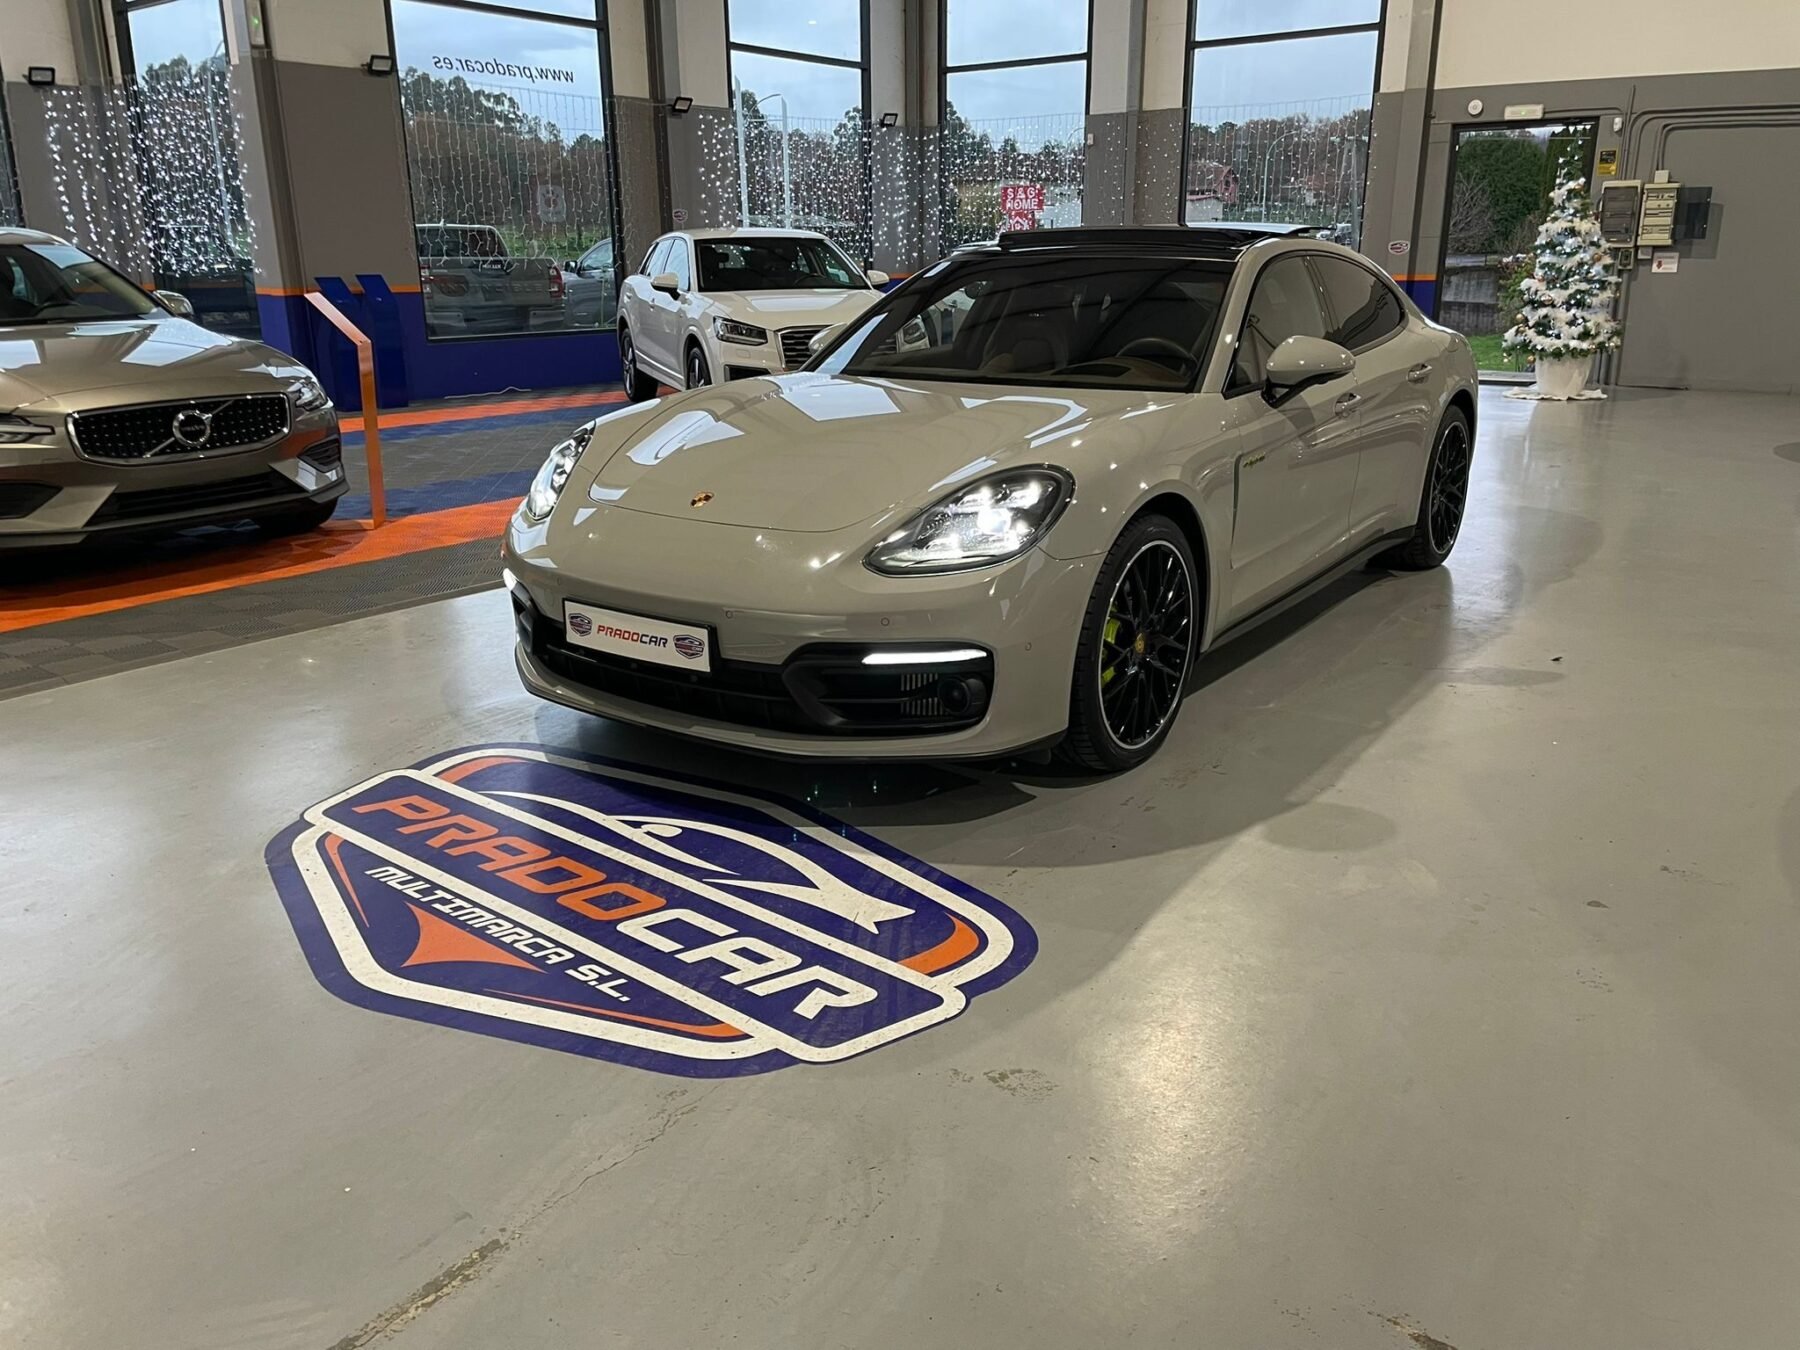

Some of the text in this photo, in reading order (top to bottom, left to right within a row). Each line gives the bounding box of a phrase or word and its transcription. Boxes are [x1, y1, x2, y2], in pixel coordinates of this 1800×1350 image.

[1006, 199, 1039, 210] HOME
[597, 625, 668, 648] PRADOCAR
[352, 795, 878, 1020] PRADOCAR
[364, 866, 631, 1002] MULTIMARCA S.L.
